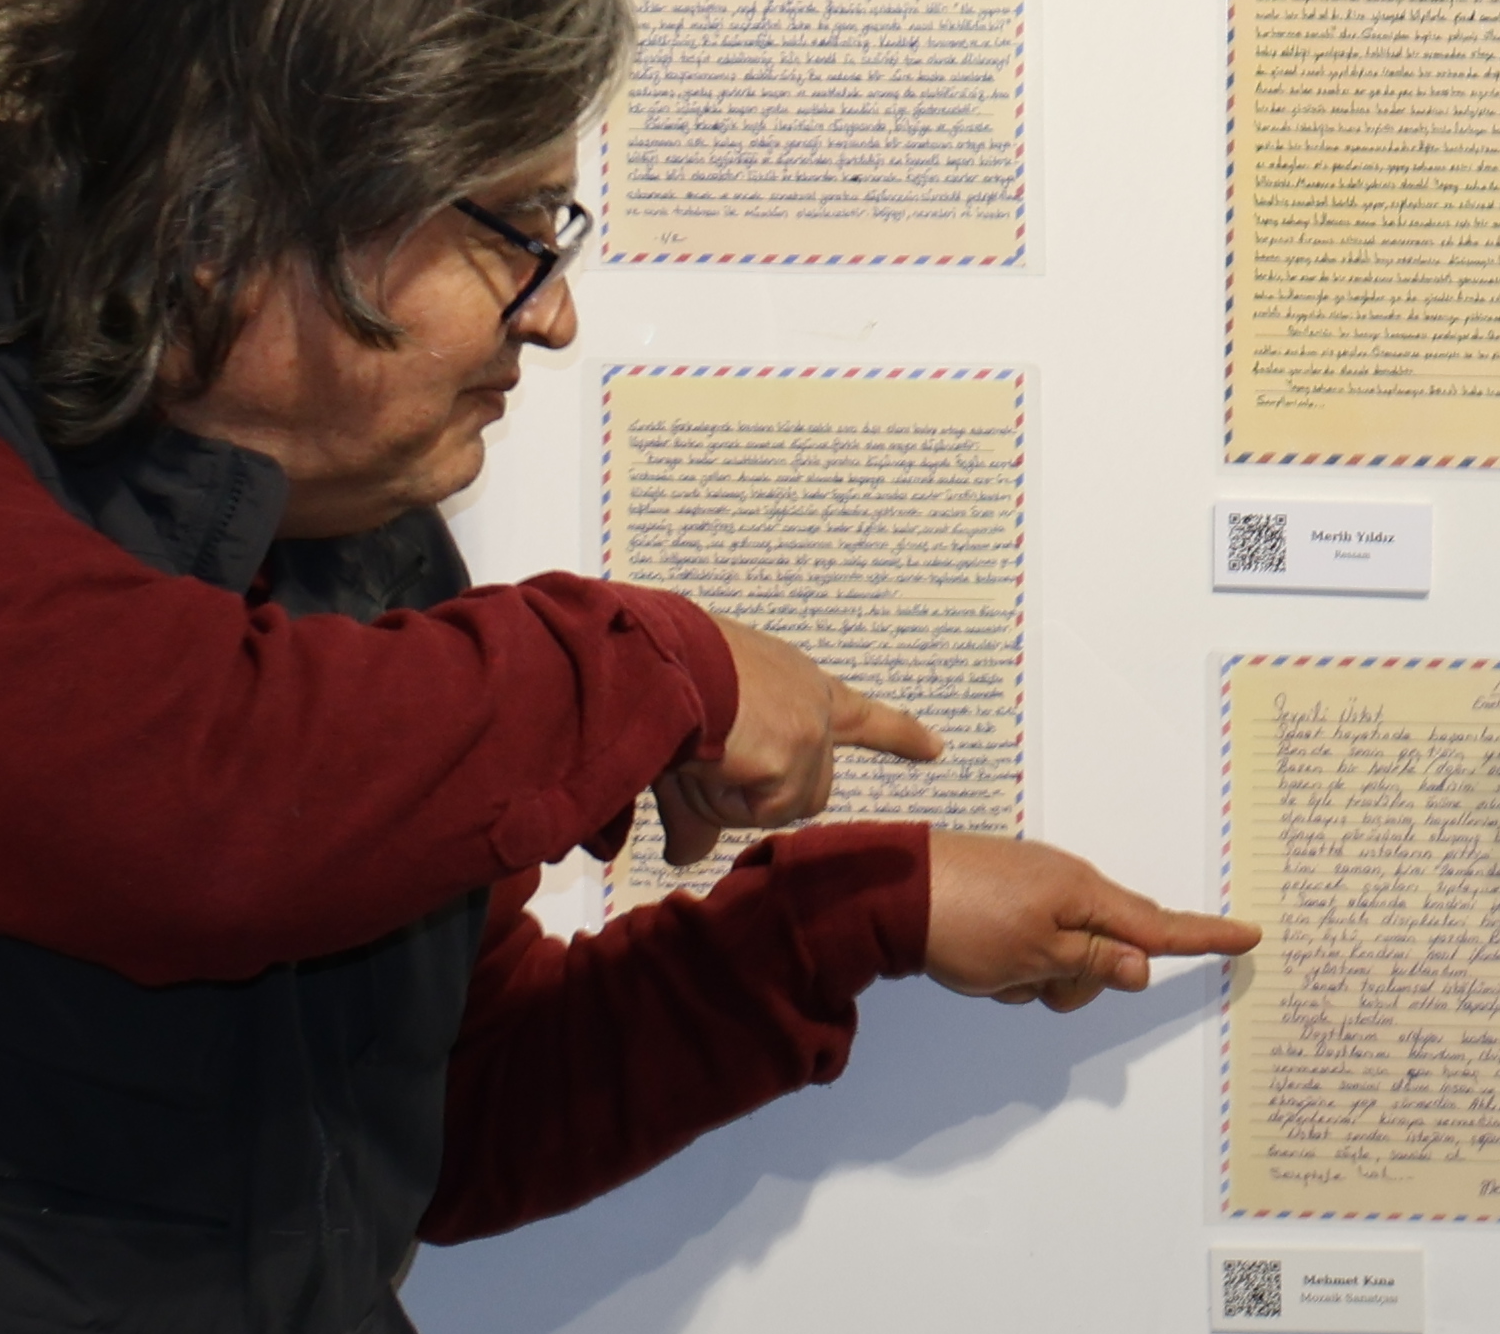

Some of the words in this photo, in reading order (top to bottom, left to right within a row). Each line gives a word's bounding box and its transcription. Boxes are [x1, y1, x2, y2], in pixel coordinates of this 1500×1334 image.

[1311, 530, 1352, 542] Merih
[1357, 531, 1396, 543] Yıldız
[1334, 549, 1372, 559] Ressam
[1276, 723, 1324, 739] Sanat
[1333, 725, 1411, 744] hayatında
[1349, 747, 1384, 757] senin
[1337, 759, 1355, 773] bir
[1359, 842, 1432, 859] ustaların
[1284, 858, 1315, 874] kimi
[1394, 862, 1425, 876] kimi
[1422, 893, 1475, 910] kendimi
[1361, 977, 1435, 993] toplumsal
[1304, 1274, 1358, 1285] Mehmet
[1364, 1274, 1396, 1286] Kına
[1301, 1292, 1341, 1302] Mozaik
[1345, 1292, 1399, 1305] Sanatçısı
